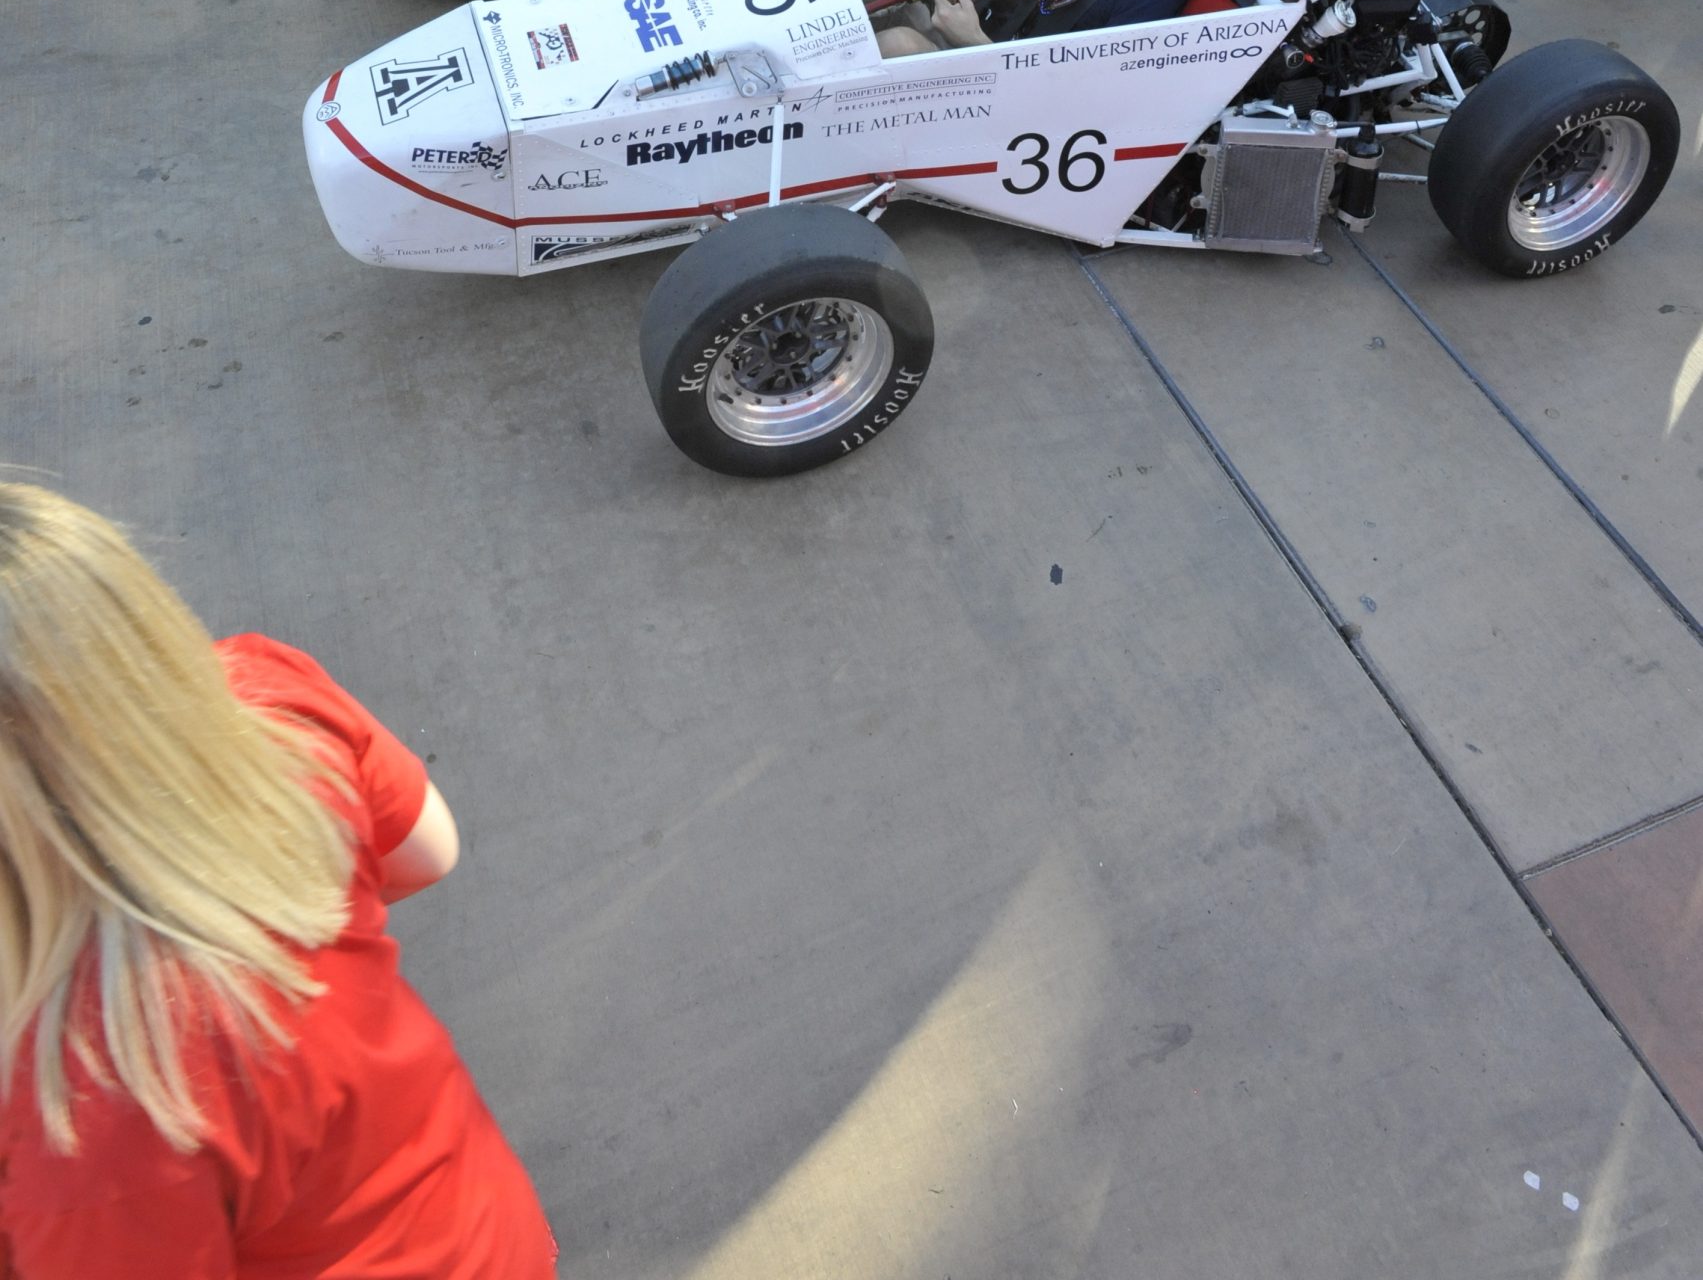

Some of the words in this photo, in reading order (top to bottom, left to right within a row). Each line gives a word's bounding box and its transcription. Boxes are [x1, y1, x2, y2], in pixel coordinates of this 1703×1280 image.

[786, 8, 862, 43] LINDEL
[792, 23, 867, 56] ENGINEERING
[1001, 52, 1041, 70] THE
[1049, 35, 1159, 63] UNIVERSITY
[1163, 32, 1190, 48] OF
[1196, 18, 1289, 44] ARIZONA
[1119, 46, 1228, 71] azengineering
[369, 47, 475, 125] A
[837, 98, 897, 112] PRECISION
[898, 88, 992, 103] MANUFACTURING
[839, 84, 903, 100] COMPETITIVE
[906, 76, 972, 90] ENGINEERING
[975, 74, 994, 84] INC.
[579, 119, 705, 149] LOCKHEED
[716, 101, 802, 126] MARTN
[821, 120, 865, 138] THE
[870, 109, 938, 132] METAL
[943, 104, 993, 121] MAN
[411, 147, 471, 164] PETER
[1002, 128, 1108, 196] 36
[534, 168, 602, 188] ACE
[395, 248, 431, 256] Tucson
[434, 246, 456, 255] Tool
[678, 303, 766, 394] Hoosier
[840, 366, 924, 454] Hoosier
